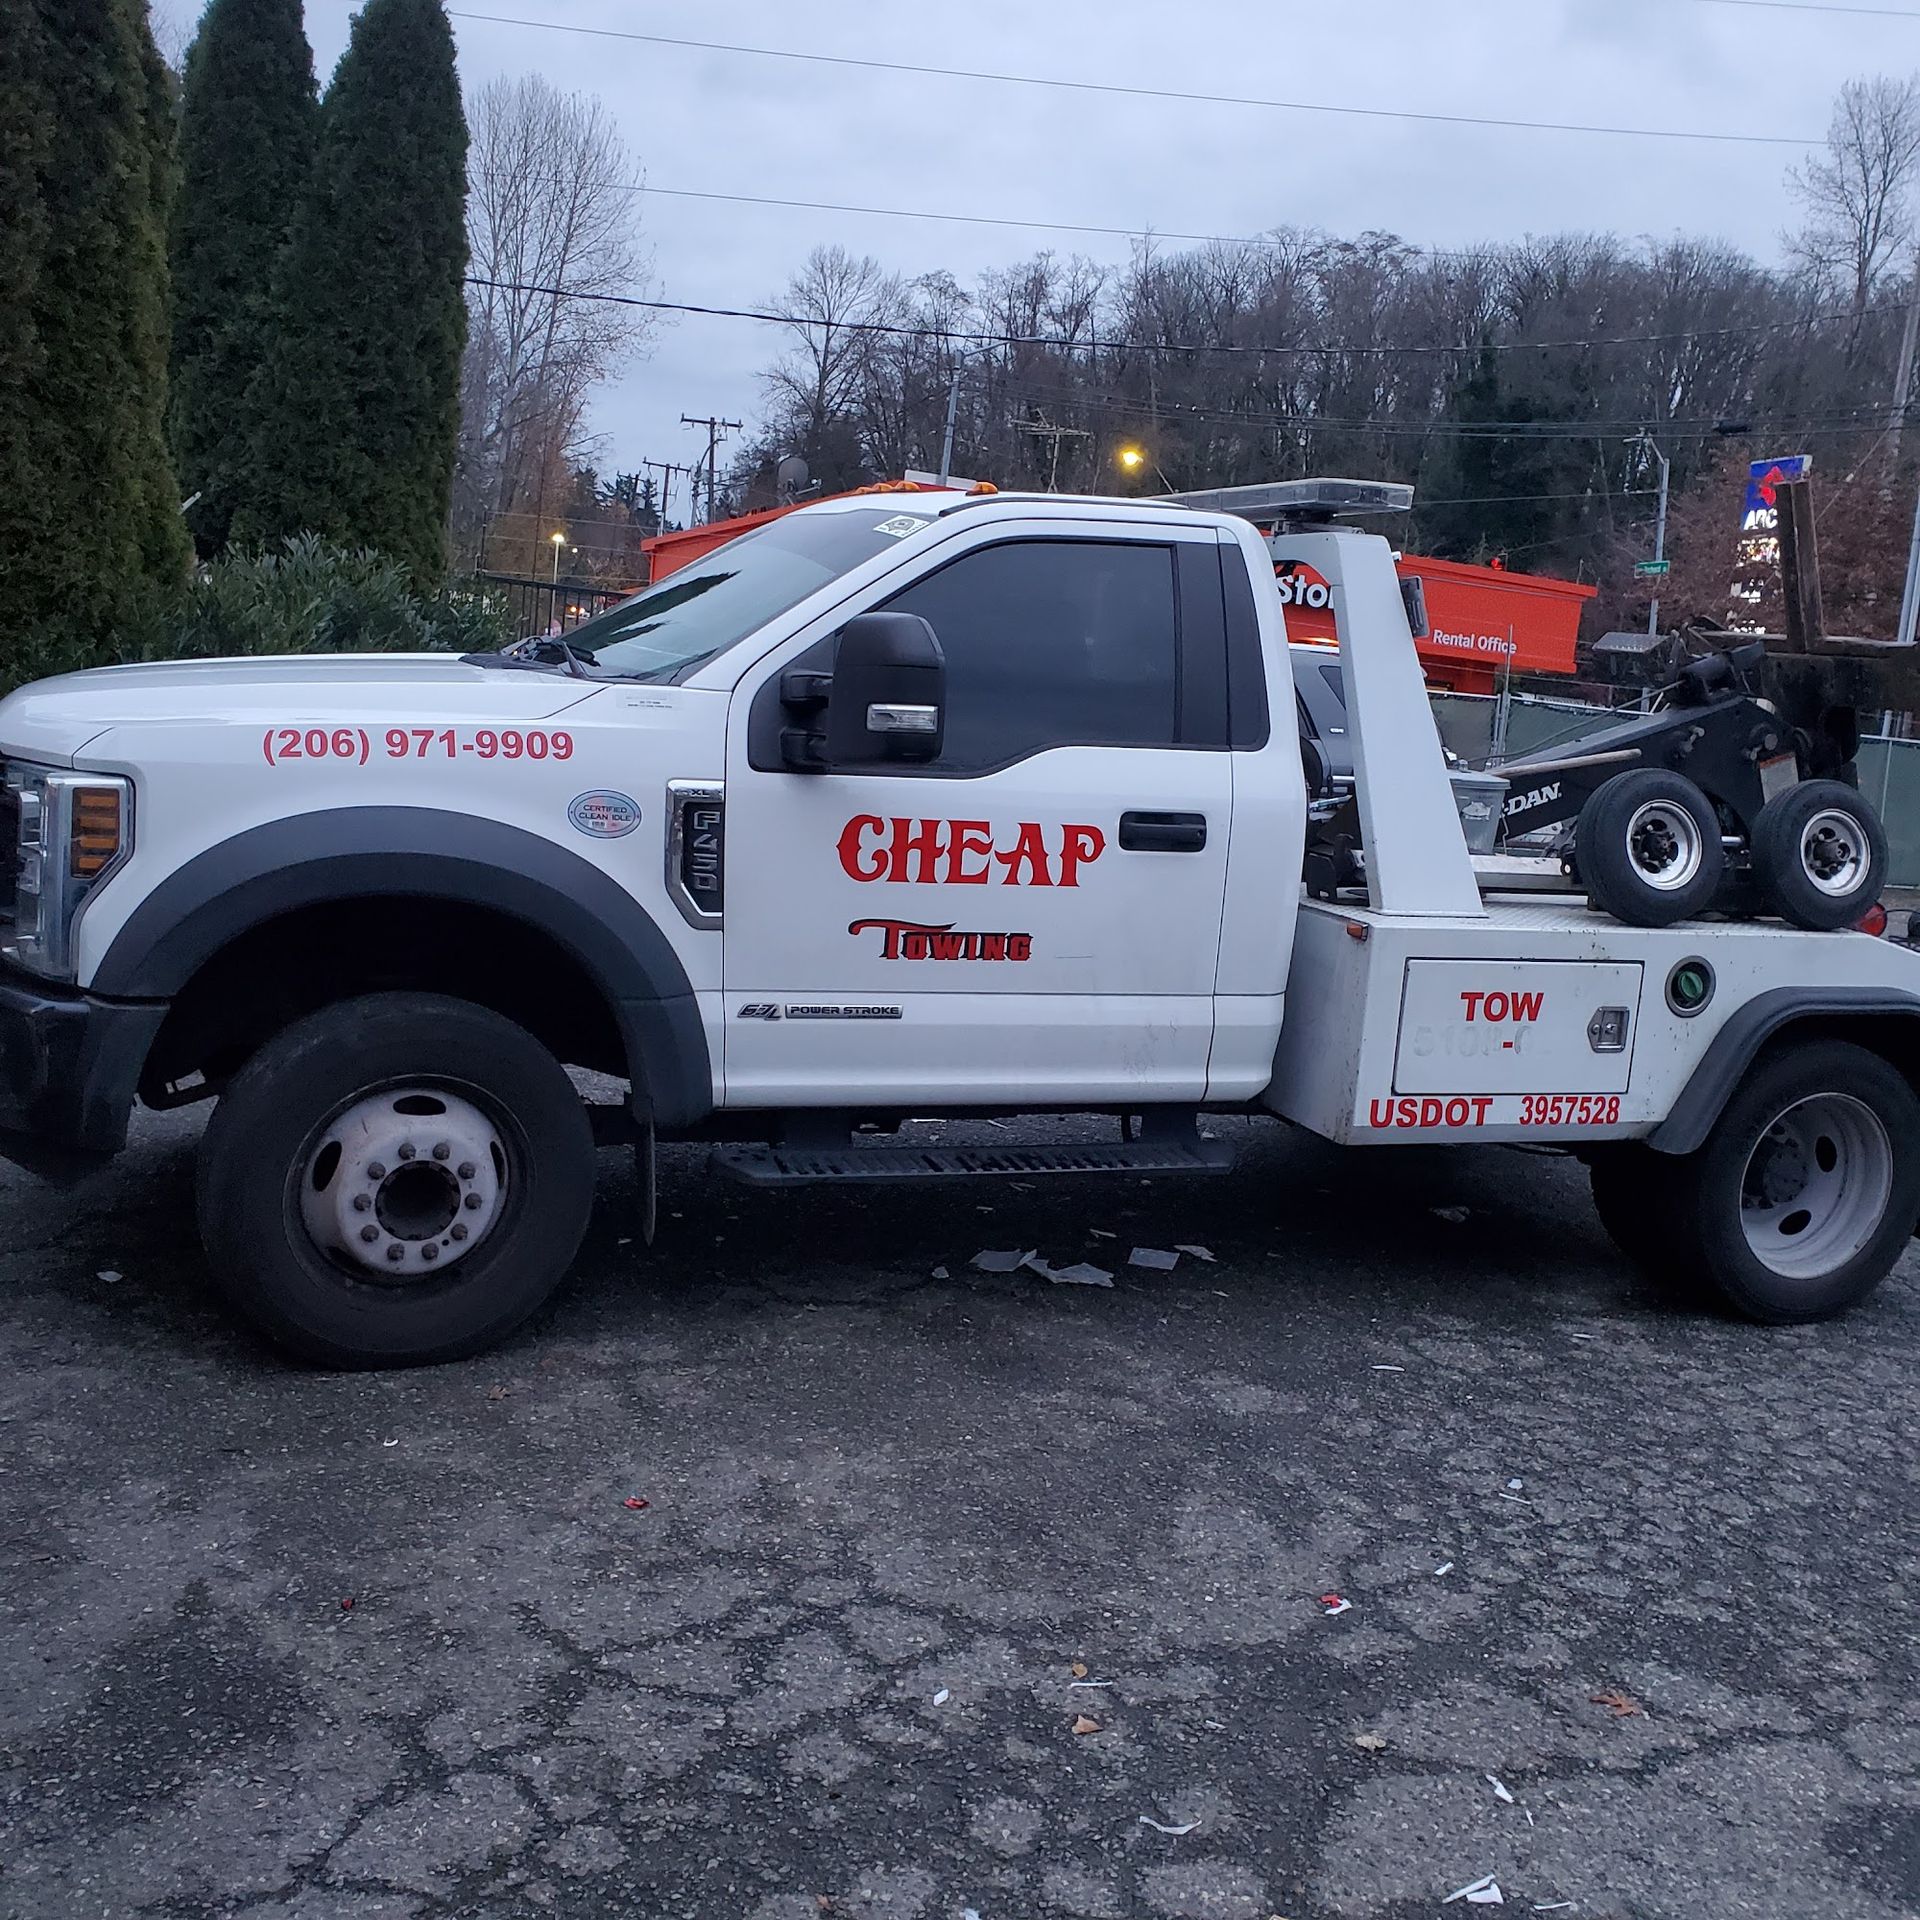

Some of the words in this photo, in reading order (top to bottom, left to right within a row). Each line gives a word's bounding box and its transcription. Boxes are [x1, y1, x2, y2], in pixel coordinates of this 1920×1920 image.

[1433, 629, 1475, 649] Rental
[1477, 635, 1517, 654] Office
[264, 729, 370, 765] (206)
[385, 729, 574, 760] 971-9909
[578, 812, 609, 820] CLEAN
[611, 814, 631, 822] IDLE
[583, 804, 627, 813] CERTIFIED
[836, 814, 1106, 887] CHEAP
[790, 1006, 840, 1014] POWER
[843, 1006, 899, 1015] STROKE
[1460, 991, 1544, 1022] TOW
[1369, 1098, 1493, 1128] USDOT
[1519, 1095, 1621, 1125] 3957528
